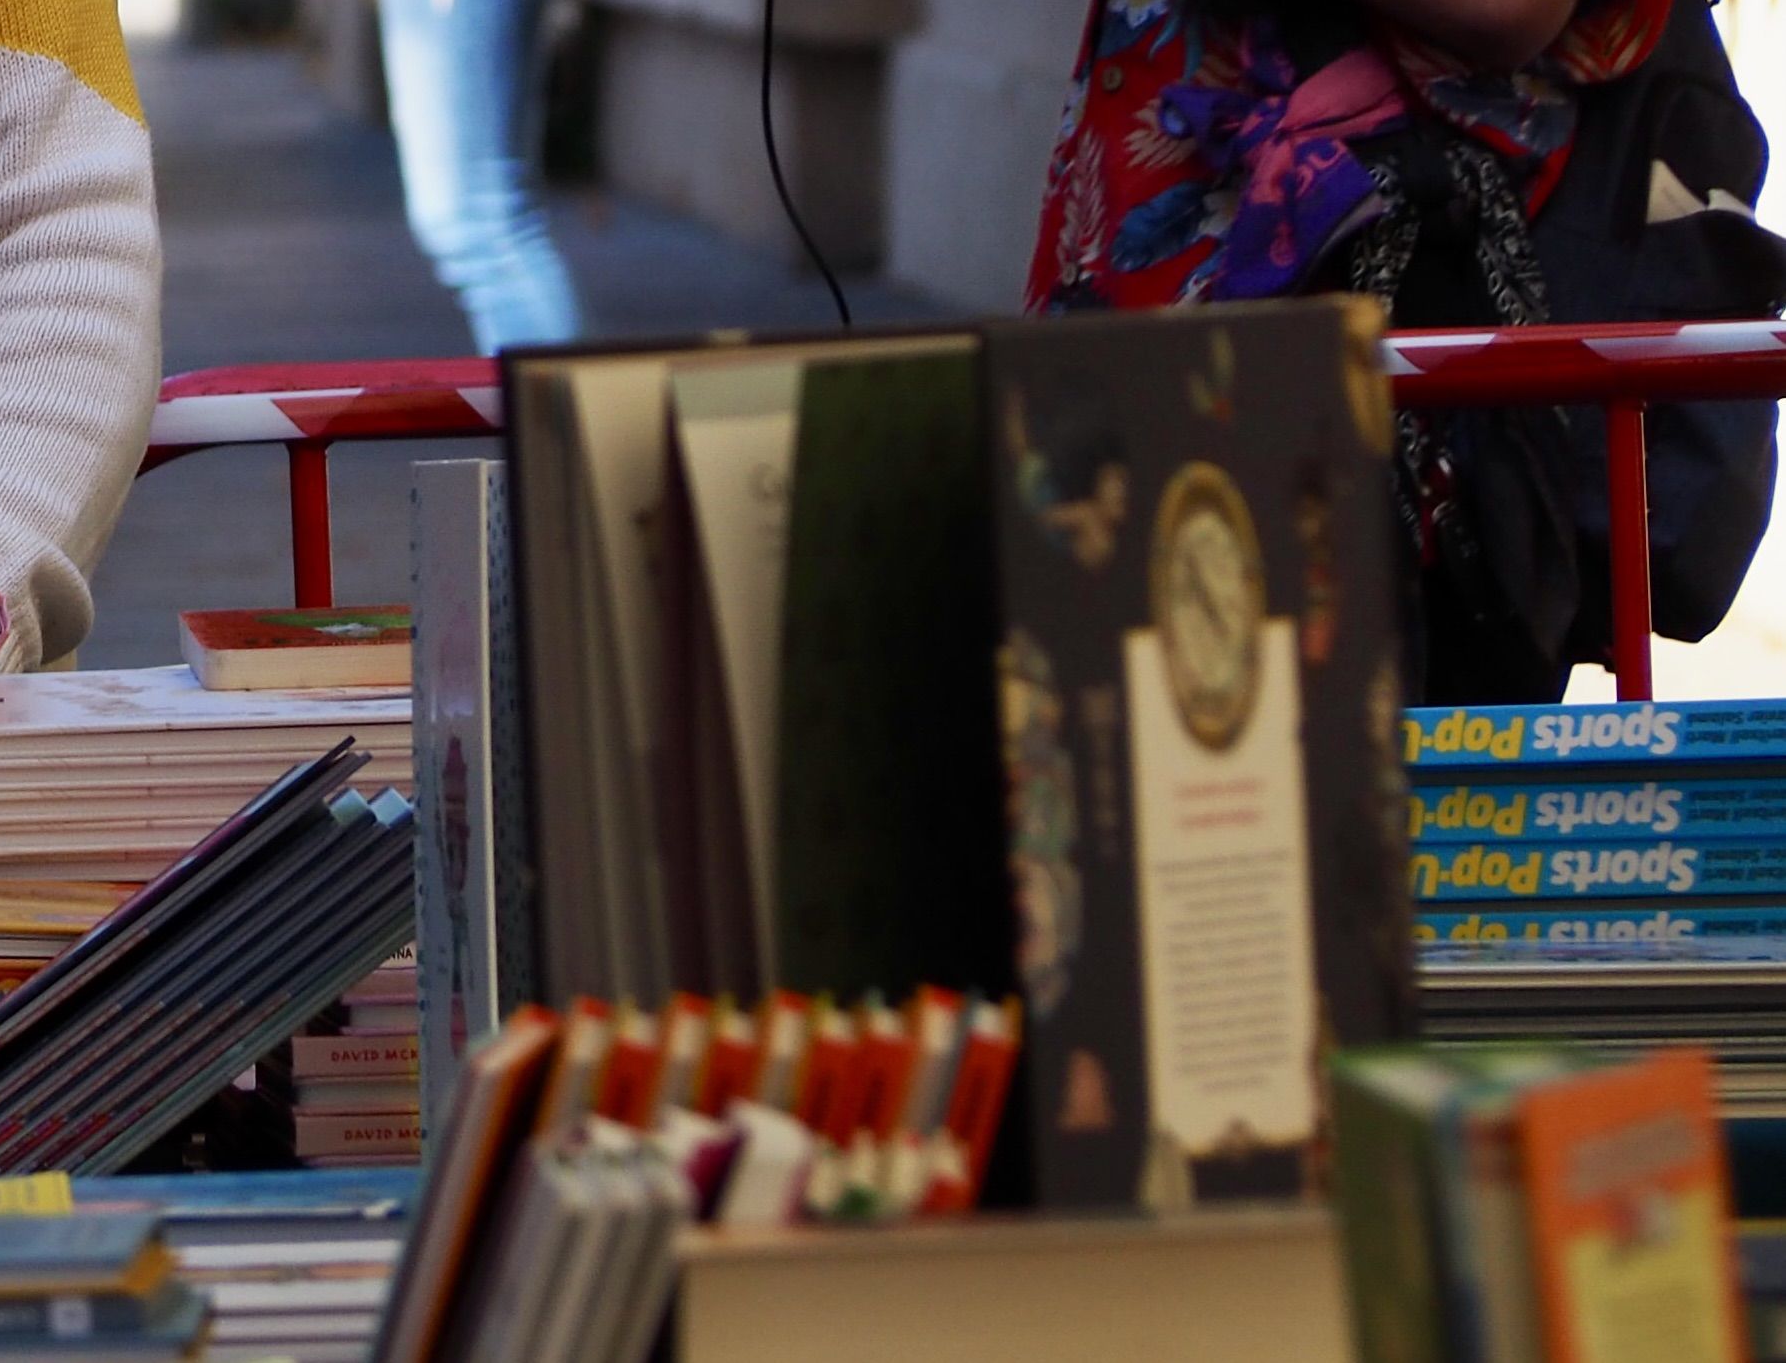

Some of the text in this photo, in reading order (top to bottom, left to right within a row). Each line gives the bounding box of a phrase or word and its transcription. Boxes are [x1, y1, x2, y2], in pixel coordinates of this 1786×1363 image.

[1533, 704, 1681, 756] Sports
[1535, 782, 1682, 833] Sports
[1550, 841, 1698, 892] Sports
[331, 1049, 379, 1061] DAVID
[343, 1128, 391, 1140] DAVID
